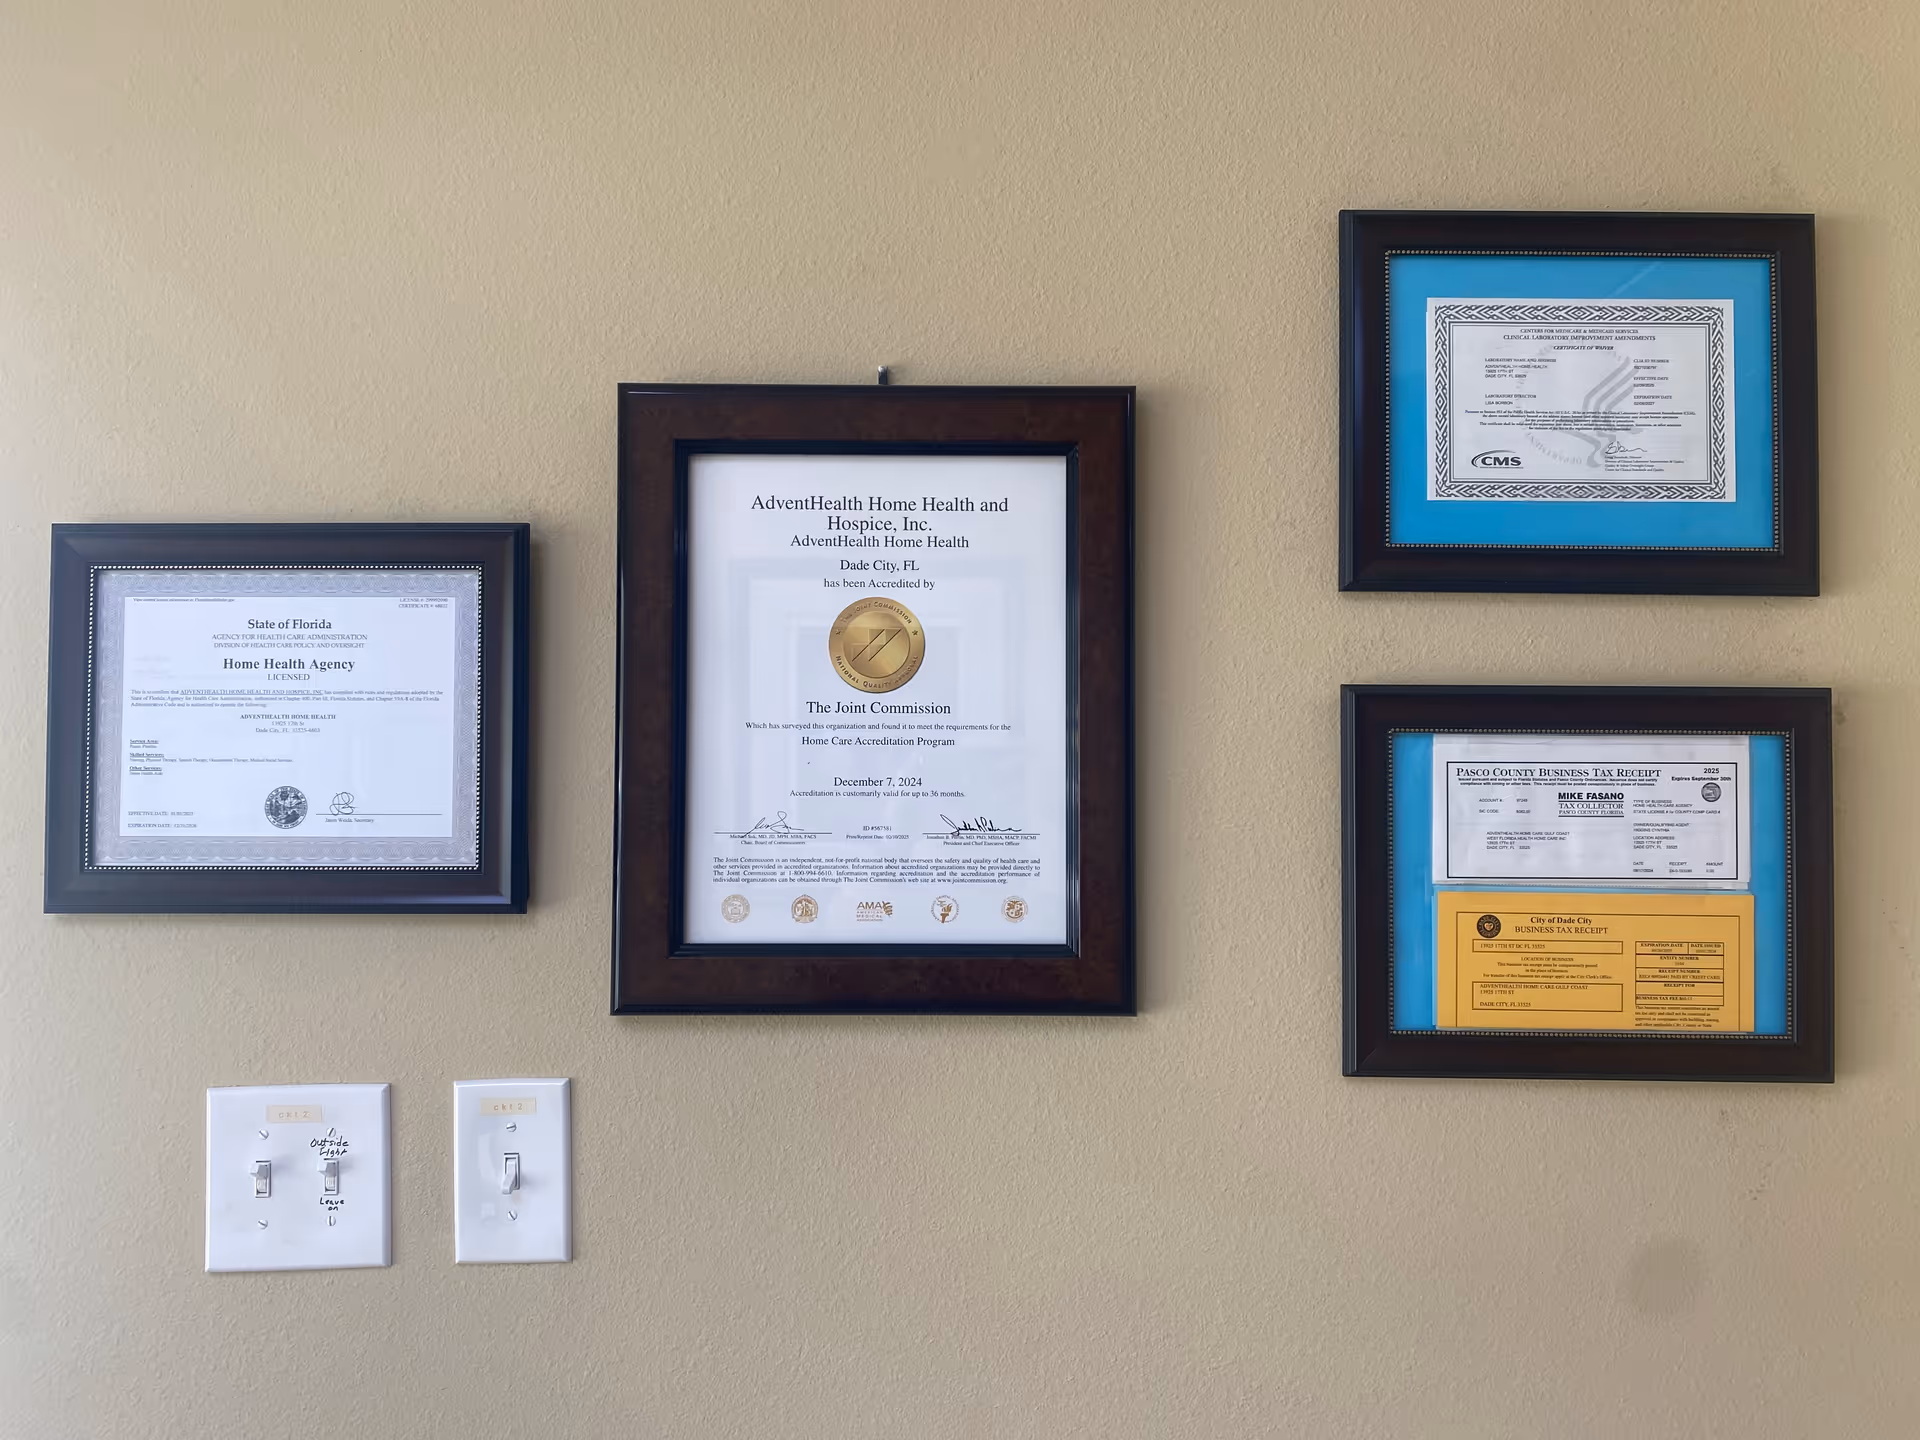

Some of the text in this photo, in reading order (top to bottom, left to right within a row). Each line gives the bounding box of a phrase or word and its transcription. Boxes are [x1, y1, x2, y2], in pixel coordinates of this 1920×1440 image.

[1481, 456, 1522, 466] CMS
[752, 495, 1008, 512] AdventHealth Home Health and
[828, 516, 931, 534] Hospice, Inc.
[791, 535, 969, 548] AdventHealth Home Health
[840, 560, 919, 572] Dade City, FL
[824, 578, 935, 590] has been Accredited by
[248, 619, 332, 629] State of Florida
[223, 658, 354, 672] Home Health Agency
[806, 701, 951, 714] The Joint Commission
[802, 736, 955, 748] Home Care Accreditation Program
[1456, 768, 1661, 777] PASCO COUNTY BUSINESS TAX RECEIPT
[834, 777, 922, 787] December 7, 2024
[842, 790, 881, 798] customarily
[1586, 792, 1625, 800] FASANO
[857, 901, 882, 910] AMA
[1530, 917, 1546, 925] City
[1577, 917, 1593, 925] City
[1574, 927, 1608, 935] RECEIPT
[310, 1136, 349, 1148] Outside
[320, 1197, 345, 1206] Leave
